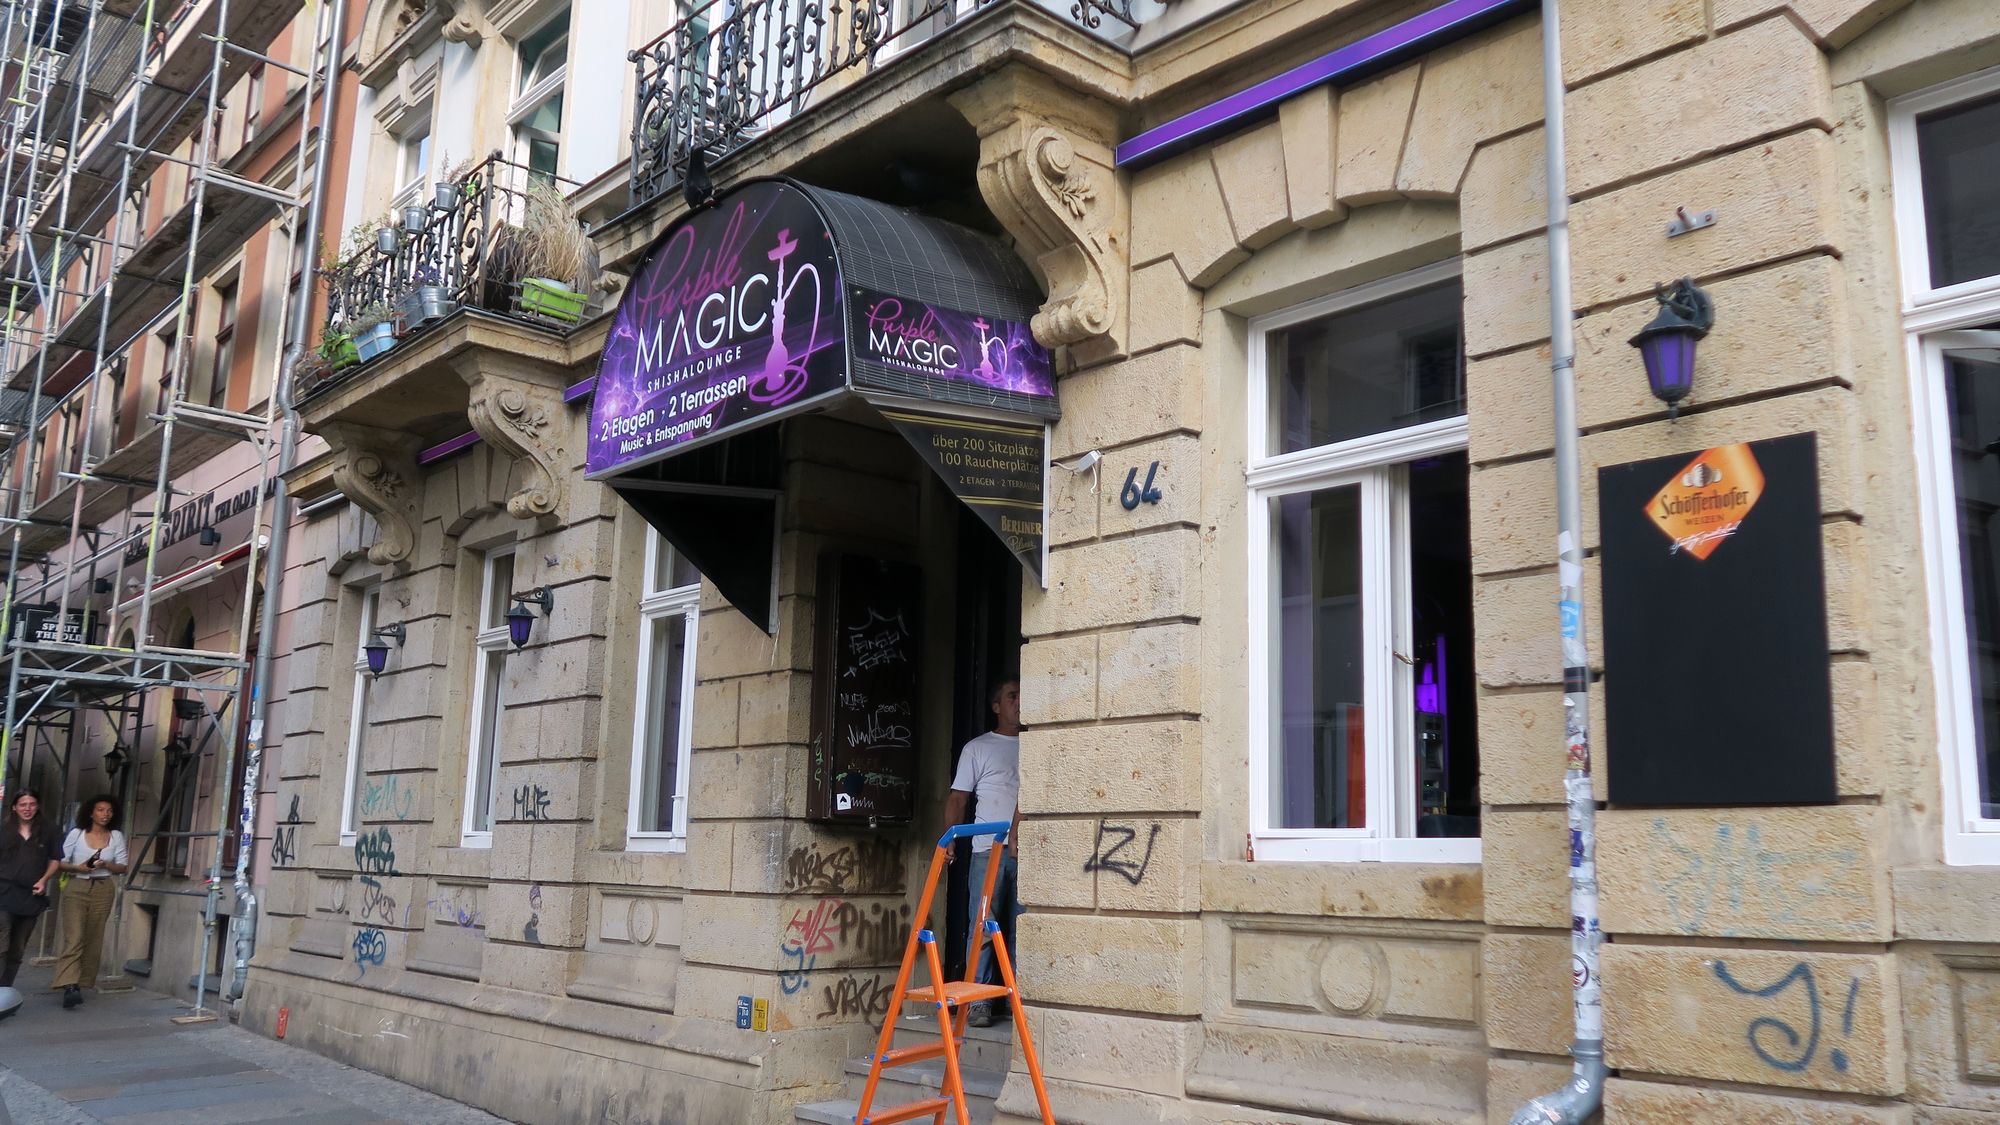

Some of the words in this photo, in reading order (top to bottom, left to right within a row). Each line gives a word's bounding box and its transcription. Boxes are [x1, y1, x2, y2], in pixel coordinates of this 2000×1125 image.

[637, 201, 744, 330] Purple
[634, 274, 770, 378] MAGIC
[865, 298, 939, 345] Purple
[646, 345, 743, 394] SHISHALOUNGE
[869, 328, 959, 369] MAGIC
[881, 355, 945, 376] SHISHALOUNGE
[600, 421, 610, 442] 2
[611, 407, 655, 441] Etagen
[669, 396, 678, 417] 2
[680, 374, 748, 414] Terrassen
[620, 435, 645, 455] Music
[646, 431, 653, 445] &
[655, 412, 713, 444] Entspannung
[932, 434, 959, 449] über
[963, 437, 985, 451] 200
[988, 441, 1040, 458] Sitzplätze
[940, 452, 961, 466] 100
[965, 454, 1040, 474] Raucherplätze
[960, 476, 964, 484] 2
[967, 477, 995, 487] ETAGEN
[1001, 479, 1006, 488] 2
[1120, 460, 1163, 511] 64
[1660, 486, 1750, 519] Schöfferhofer
[162, 491, 215, 547] SPIRIT
[233, 488, 251, 514] OLD
[1001, 515, 1042, 536] BERLINER
[1684, 513, 1725, 526] WEIZEN
